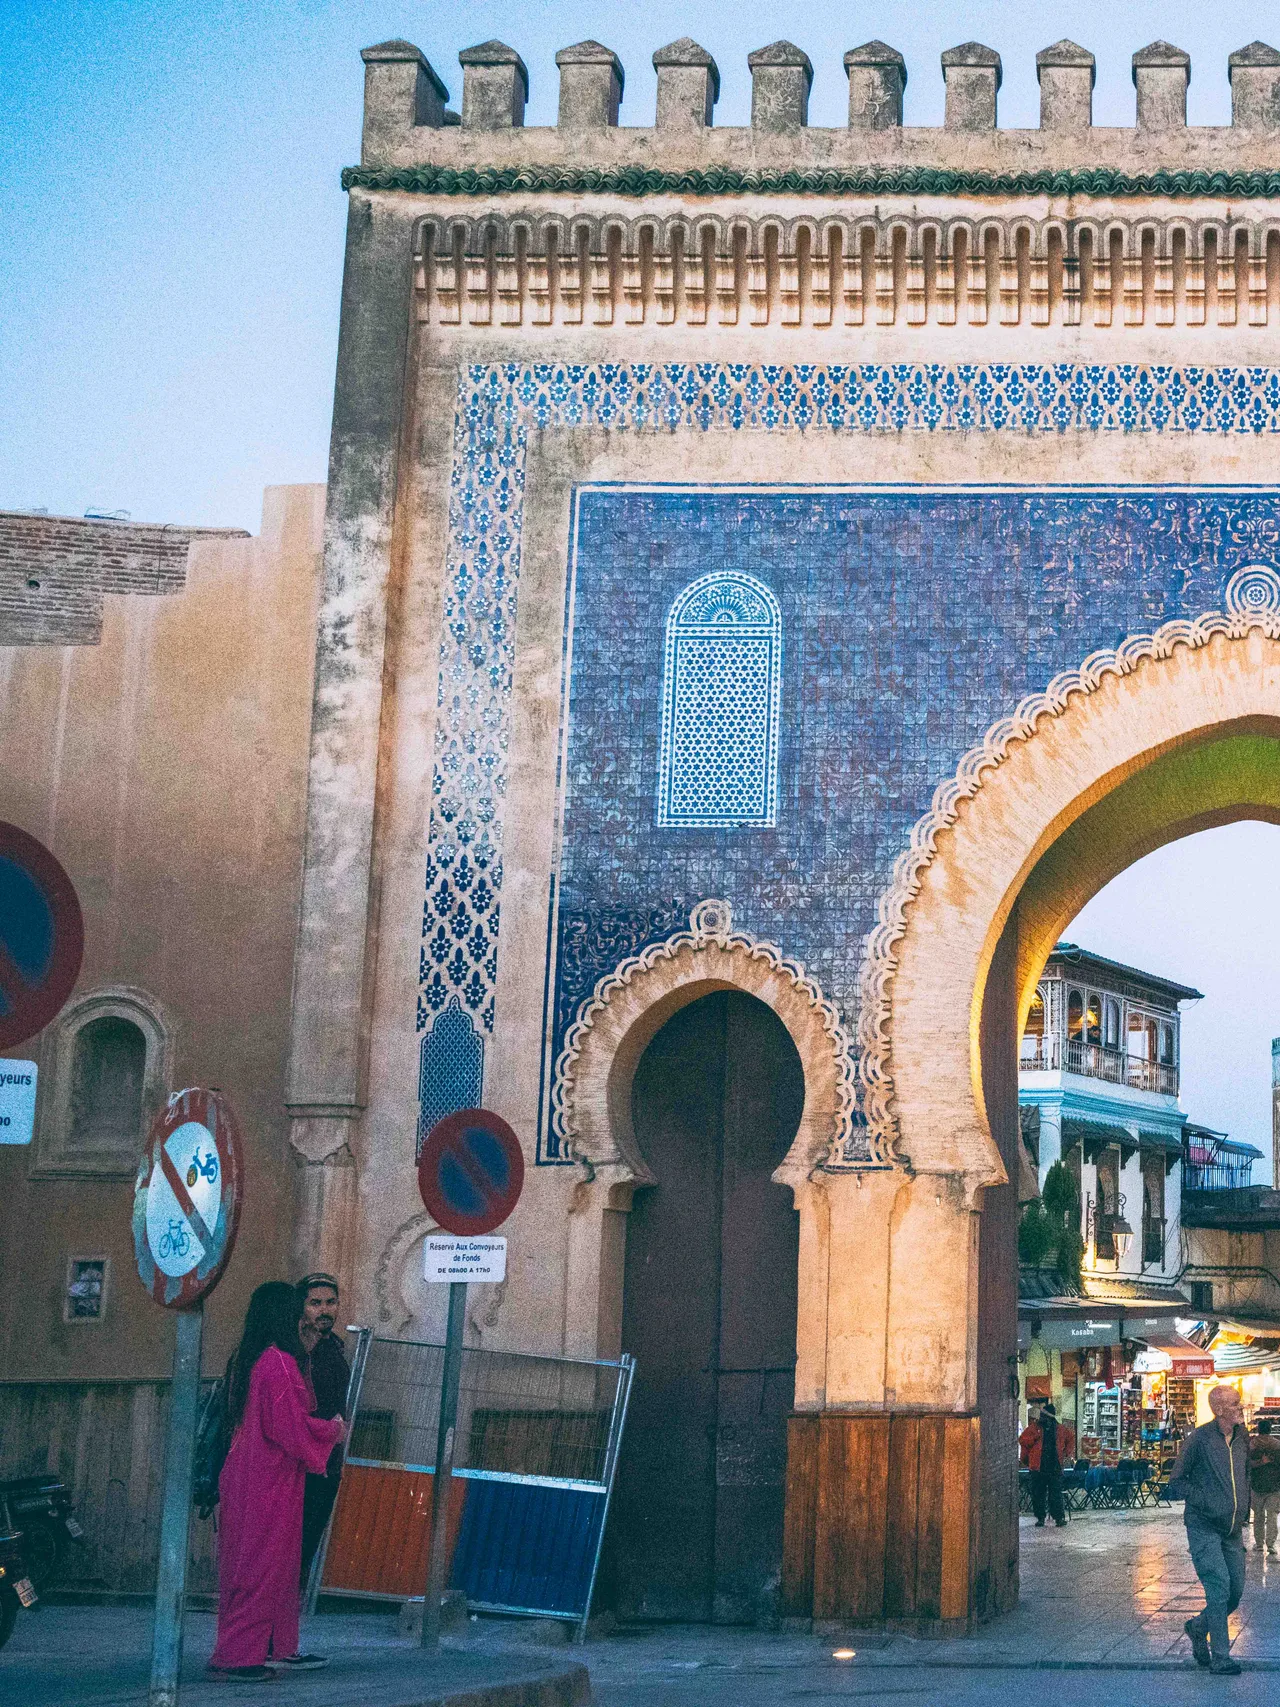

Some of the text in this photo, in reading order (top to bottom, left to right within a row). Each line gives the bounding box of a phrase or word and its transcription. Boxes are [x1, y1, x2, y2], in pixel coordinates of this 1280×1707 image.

[455, 1242, 468, 1251] Aux
[453, 1253, 481, 1262] de Fonds
[1071, 1328, 1094, 1336] Kasaba
